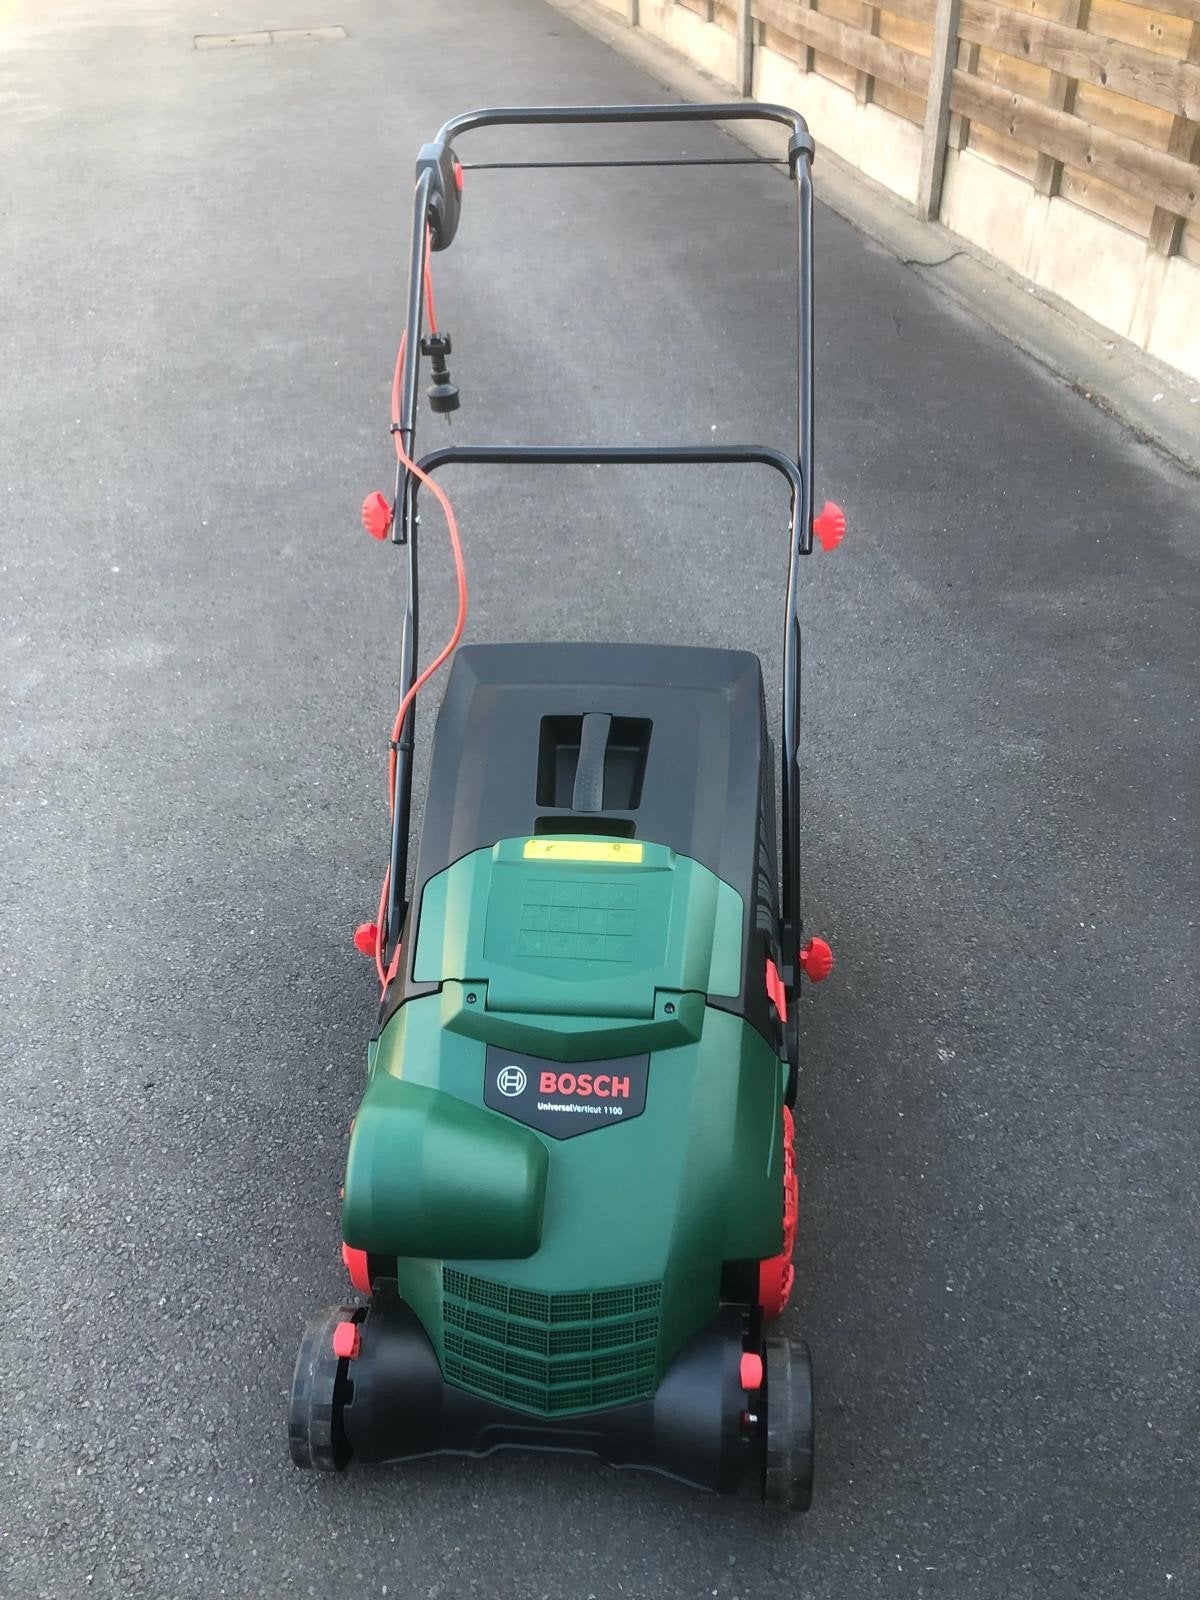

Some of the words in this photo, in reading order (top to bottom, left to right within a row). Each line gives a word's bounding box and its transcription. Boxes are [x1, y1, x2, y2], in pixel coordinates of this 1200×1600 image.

[539, 1071, 630, 1097] BOSCH
[537, 1102, 602, 1114] UniversalVerticut
[604, 1106, 623, 1115] 1100
